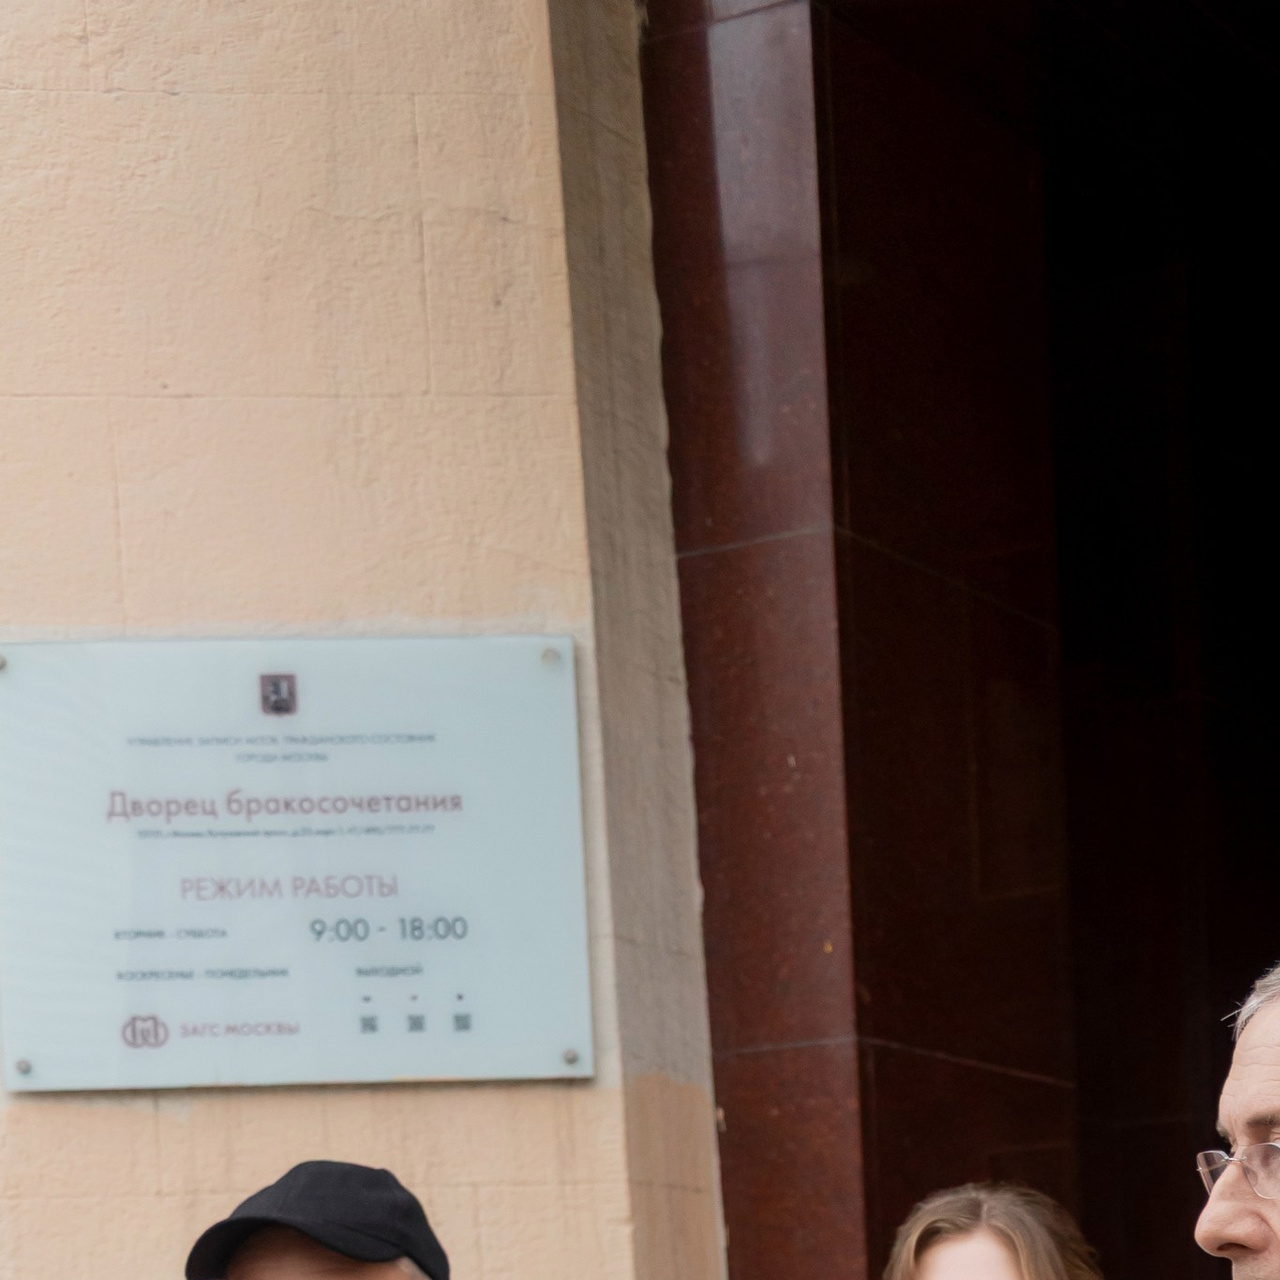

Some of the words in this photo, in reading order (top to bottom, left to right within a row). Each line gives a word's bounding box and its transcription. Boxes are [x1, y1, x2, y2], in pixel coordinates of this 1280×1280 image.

[107, 791, 218, 824] Дворец
[226, 787, 463, 823] бракосочетания
[180, 876, 284, 900] РЕЖИМ
[291, 874, 399, 899] РАБОТЫ
[310, 917, 370, 942] 9:00
[398, 915, 468, 941] 18:00
[224, 1021, 300, 1036] МОСКВЫ
